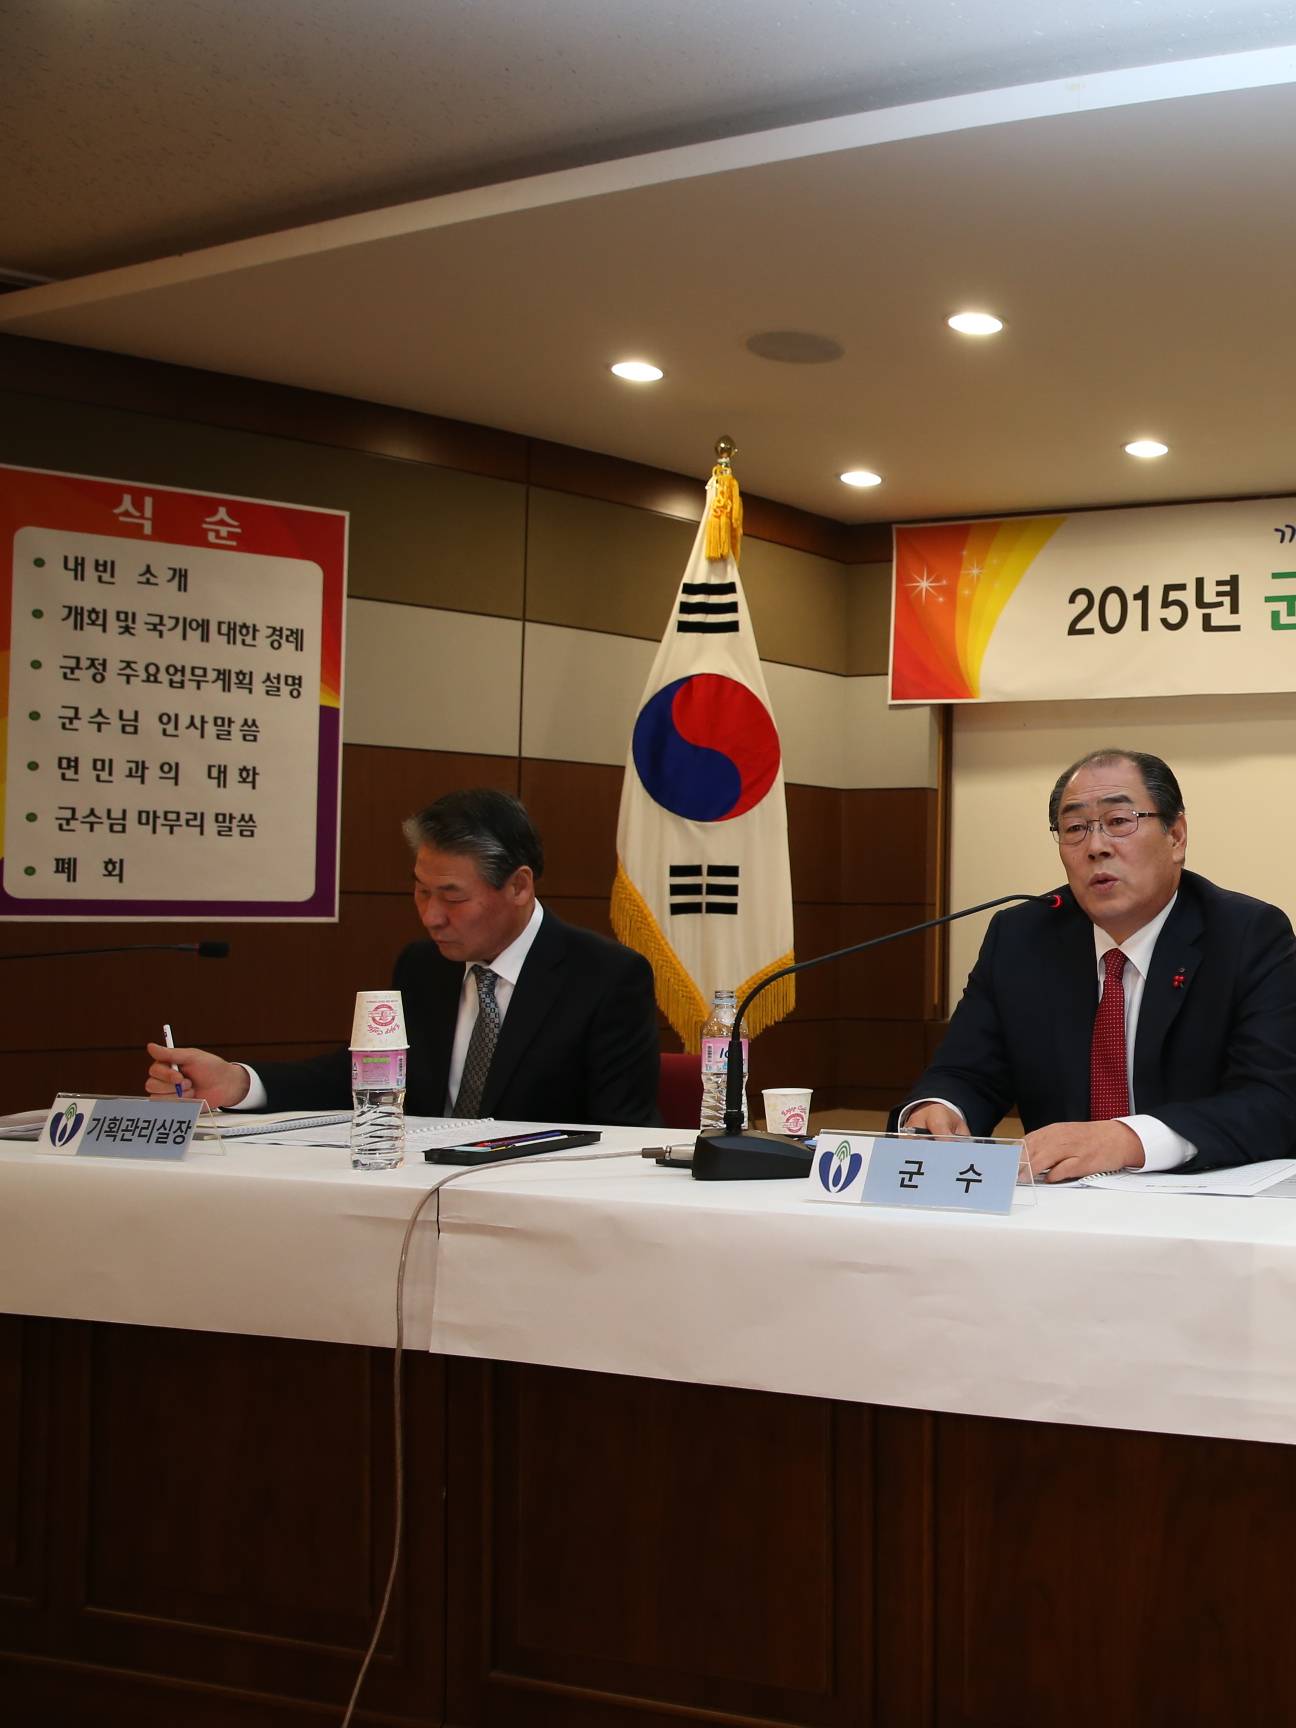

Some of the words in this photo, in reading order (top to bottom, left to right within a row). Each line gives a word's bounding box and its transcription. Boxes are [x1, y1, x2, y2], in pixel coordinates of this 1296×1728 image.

[112, 493, 154, 535] 식
[202, 505, 242, 546] 순
[63, 554, 117, 586] 내빈
[137, 562, 189, 592] 소개
[1066, 574, 1242, 637] 2015년
[61, 604, 108, 634] 개회
[115, 610, 138, 636] 및
[144, 612, 210, 643] 국기에
[217, 620, 260, 647] 대한
[265, 625, 305, 652] 경례
[59, 654, 108, 684] 군정
[117, 660, 254, 695] 주요업무계획
[261, 671, 304, 699] 설명
[58, 705, 140, 735] 군수님
[158, 711, 260, 743] 인사말씀
[57, 756, 180, 786] 면민과의
[207, 763, 260, 790] 대화
[54, 806, 128, 835] 군수님
[137, 808, 205, 836] 마무리
[214, 812, 258, 838] 말씀
[53, 856, 77, 882] 폐
[102, 858, 125, 883] 회
[86, 1115, 192, 1145] 기획관리실장
[899, 1160, 925, 1189] 군
[955, 1163, 983, 1194] 수
